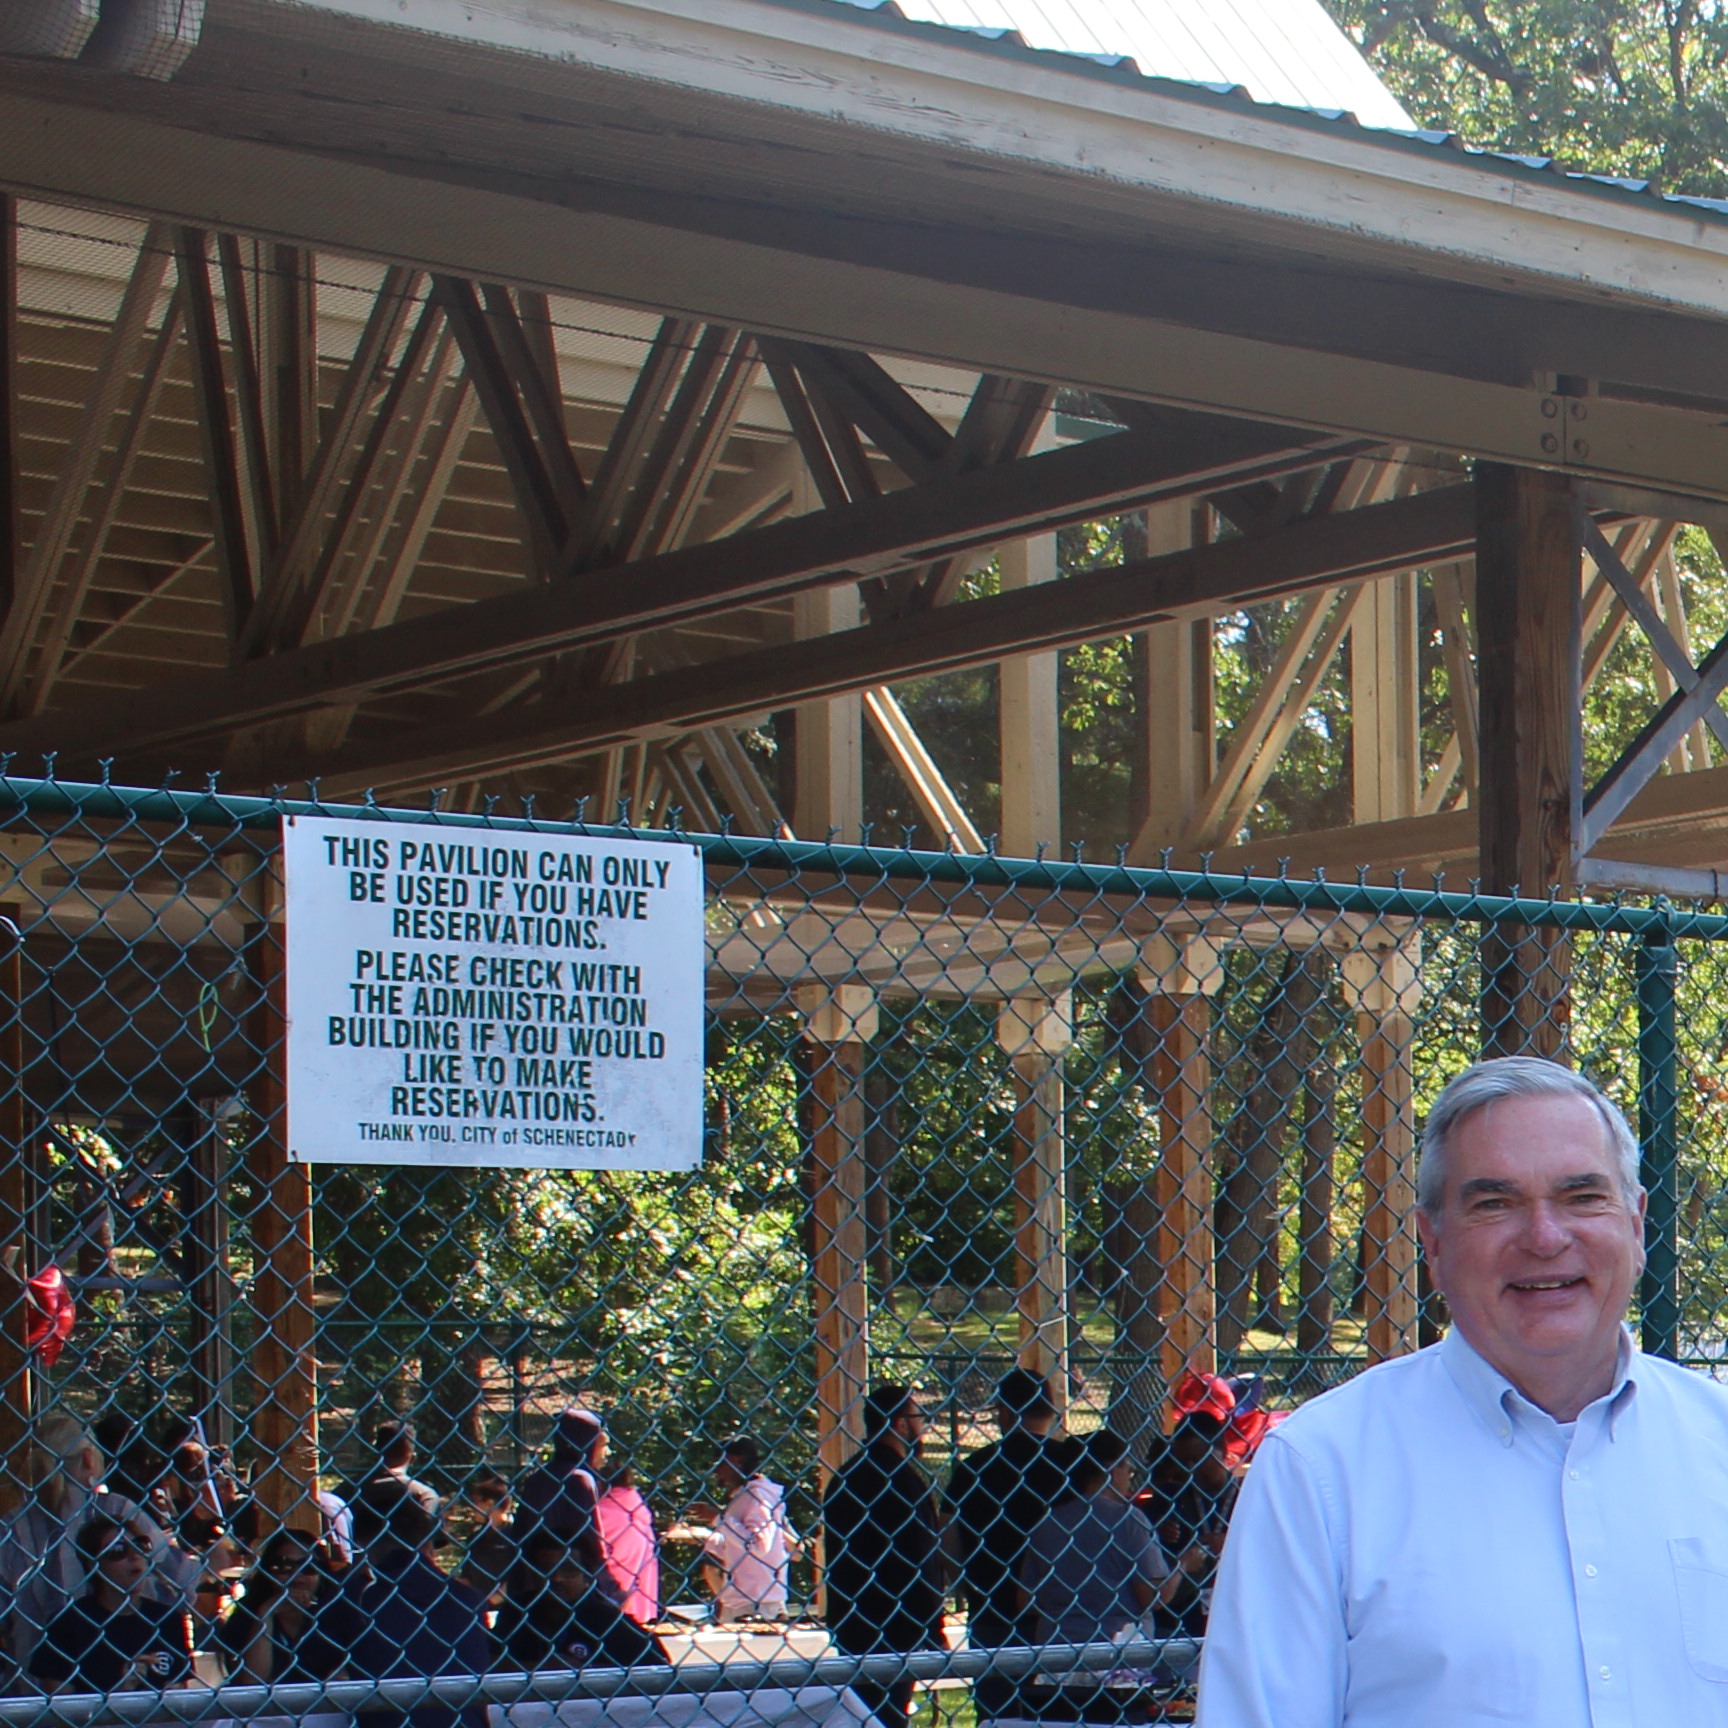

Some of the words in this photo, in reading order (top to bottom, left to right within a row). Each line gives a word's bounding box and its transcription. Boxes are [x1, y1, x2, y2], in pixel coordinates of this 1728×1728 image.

[323, 835, 389, 870] THIS
[400, 841, 528, 880] PAVILION
[538, 851, 592, 884] CAN
[603, 856, 670, 889] ONLY
[349, 871, 385, 903] BE
[397, 875, 468, 908] USED
[479, 880, 504, 911] IF
[512, 883, 567, 915] YOU
[576, 887, 647, 920] HAVE
[393, 908, 606, 950] RESERVATIONS.
[356, 950, 460, 985] PLEASE
[468, 956, 563, 991] CHECK
[571, 962, 640, 995] WITH
[349, 983, 403, 1016] THE
[412, 987, 646, 1027] ADMINISTRATION
[328, 1016, 460, 1052] BUILDING
[470, 1023, 496, 1054] IF
[503, 1024, 558, 1056] YOU
[568, 1027, 665, 1060] WOULD
[403, 1053, 462, 1085] LIKE
[471, 1055, 506, 1087] TO
[513, 1058, 592, 1091] MAKE
[391, 1086, 604, 1124] RESERVATIONS.
[358, 1123, 413, 1142] THANK
[418, 1125, 456, 1143] YOU.
[461, 1126, 497, 1144] CITY
[502, 1128, 518, 1145] of
[523, 1128, 636, 1148] SCHENECTADY
